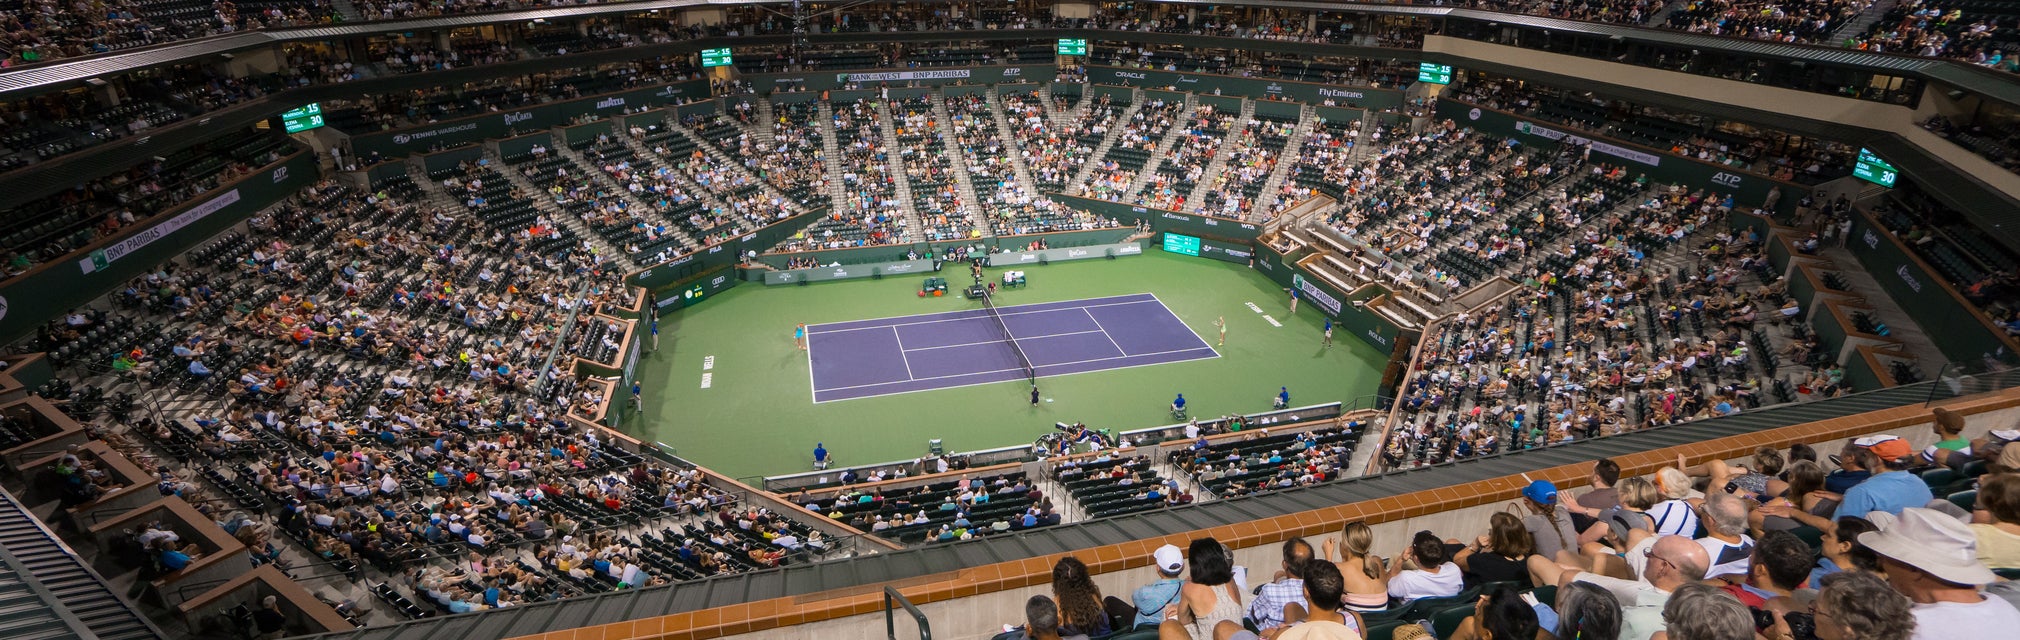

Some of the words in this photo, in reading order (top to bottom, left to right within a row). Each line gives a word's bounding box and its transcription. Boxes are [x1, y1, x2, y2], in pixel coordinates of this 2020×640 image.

[1319, 88, 1332, 97] Fly
[1332, 90, 1363, 98] Emirates
[307, 103, 318, 113] 15
[310, 115, 321, 125] 30
[411, 130, 437, 140] TENNIS
[438, 123, 477, 135] WAREHOUSE
[1532, 125, 1545, 136] BNP
[273, 167, 287, 180] ATP
[1712, 172, 1741, 183] ATP
[1881, 171, 1894, 183] 30
[107, 244, 124, 260] BNP
[127, 227, 160, 250] PARIBAS
[709, 245, 722, 254] FILA
[669, 255, 693, 267] ORACLE
[640, 270, 652, 279] ATP
[1304, 282, 1315, 293] BNP
[1316, 290, 1339, 310] PARIBAS
